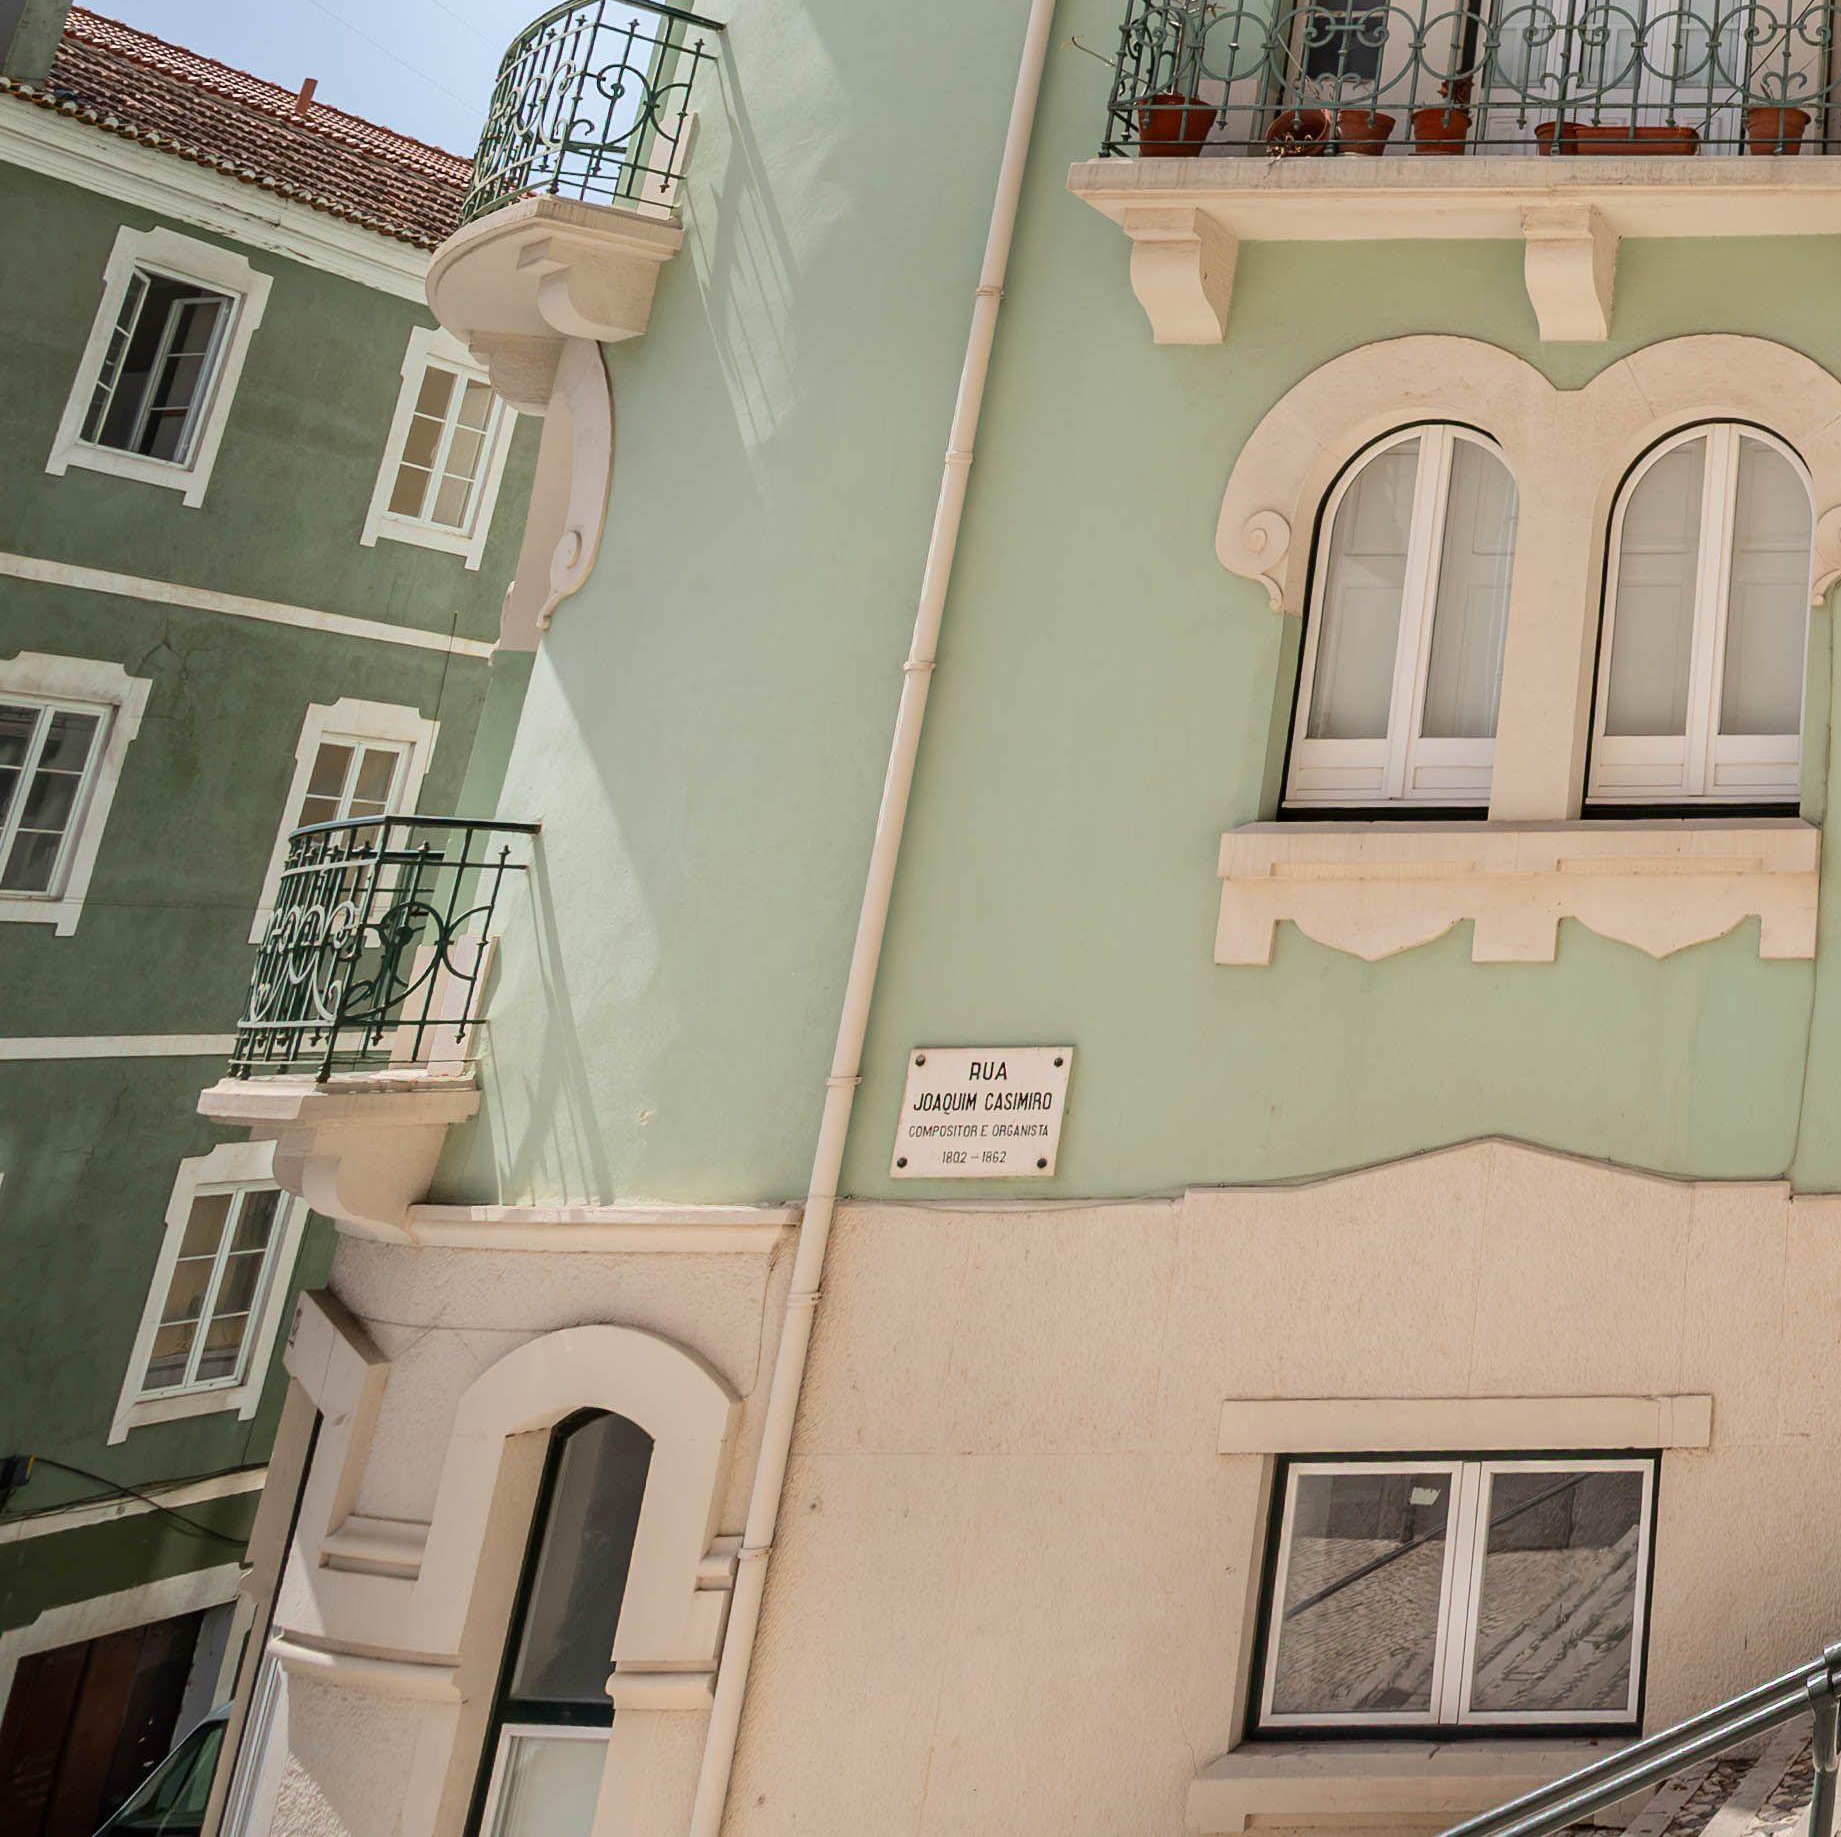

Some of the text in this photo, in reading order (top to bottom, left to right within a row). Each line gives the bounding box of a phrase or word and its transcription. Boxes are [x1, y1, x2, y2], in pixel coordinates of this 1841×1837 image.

[969, 1061, 1008, 1081] RUA
[913, 1092, 1053, 1115] JOAQUIM CASIMIRO
[908, 1124, 1049, 1138] COMPOSITOR E ORGANISTA
[942, 1151, 968, 1164] 1802
[981, 1150, 1007, 1163] 1862
